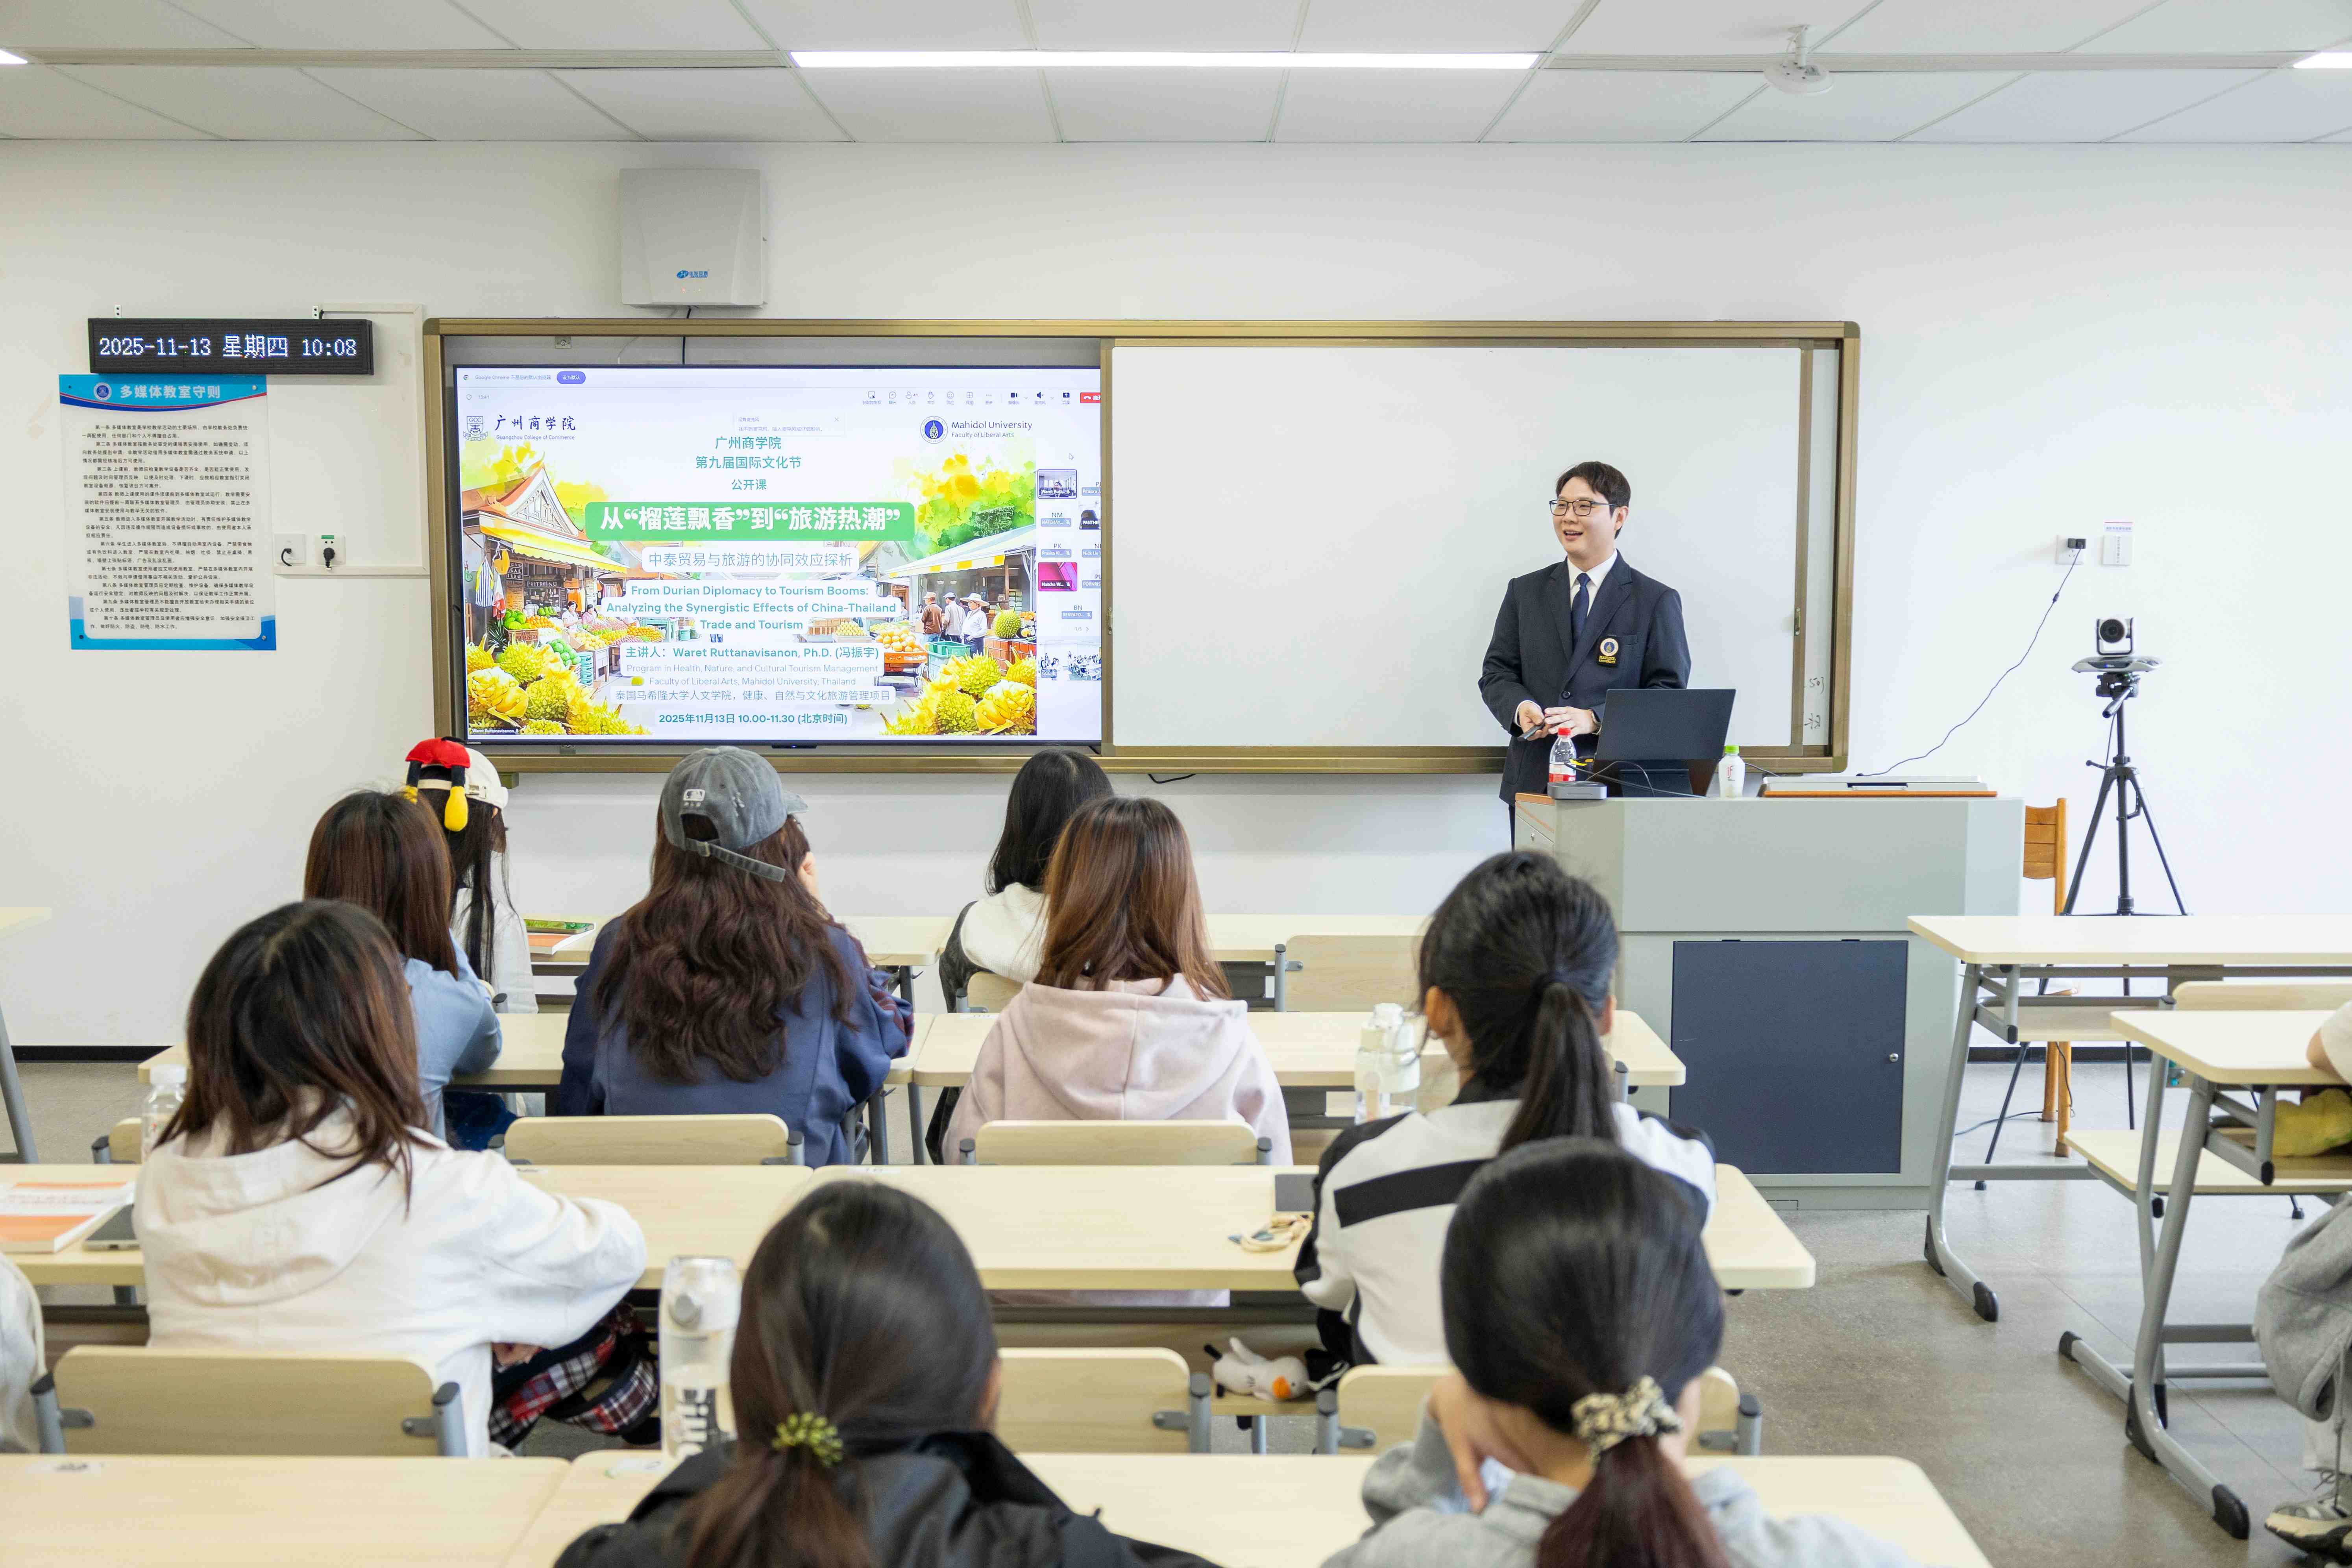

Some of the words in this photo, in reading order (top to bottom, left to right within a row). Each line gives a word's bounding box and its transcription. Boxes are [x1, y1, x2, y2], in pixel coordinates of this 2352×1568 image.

[99, 338, 211, 355] 2025-11-13
[223, 335, 288, 358] 星期四
[302, 338, 357, 356] 10:08
[120, 384, 220, 399] 多媒体教室守则
[495, 414, 576, 431] 广州商学院
[952, 420, 986, 429] Mahidol
[989, 420, 1033, 431] University
[715, 436, 781, 449] 广州商学院
[695, 456, 802, 469] 第九届国际文化节
[731, 479, 767, 490] 公开课
[649, 553, 852, 567] 中泰贸易与旅游的协同效应探析
[631, 586, 660, 595] From
[663, 586, 699, 595] Durian
[703, 586, 762, 597] Diplomacy
[765, 586, 777, 595] to
[779, 586, 824, 595] Tourism
[827, 586, 868, 595] Booms:
[606, 603, 661, 614] Analyzing
[664, 603, 683, 612] the
[686, 603, 750, 614] Synergistic
[753, 603, 794, 612] Effects
[797, 603, 808, 612] of
[812, 603, 896, 612] China-Thailand
[700, 620, 732, 629] Trade
[735, 620, 755, 629] and
[758, 620, 803, 629] Tourism
[673, 648, 707, 657] Waret
[710, 648, 800, 658] Ruttanavisanon,
[804, 648, 832, 657] Ph.D.
[835, 647, 878, 660] (冯振宇)
[626, 664, 662, 674] Program
[673, 664, 702, 673] Health,
[705, 664, 734, 673] Nature,
[823, 664, 878, 674] Management
[649, 677, 679, 686] Faculty
[777, 678, 819, 686] University,
[659, 713, 734, 723] 2025年11月13日
[798, 713, 847, 725] (北京时间)
